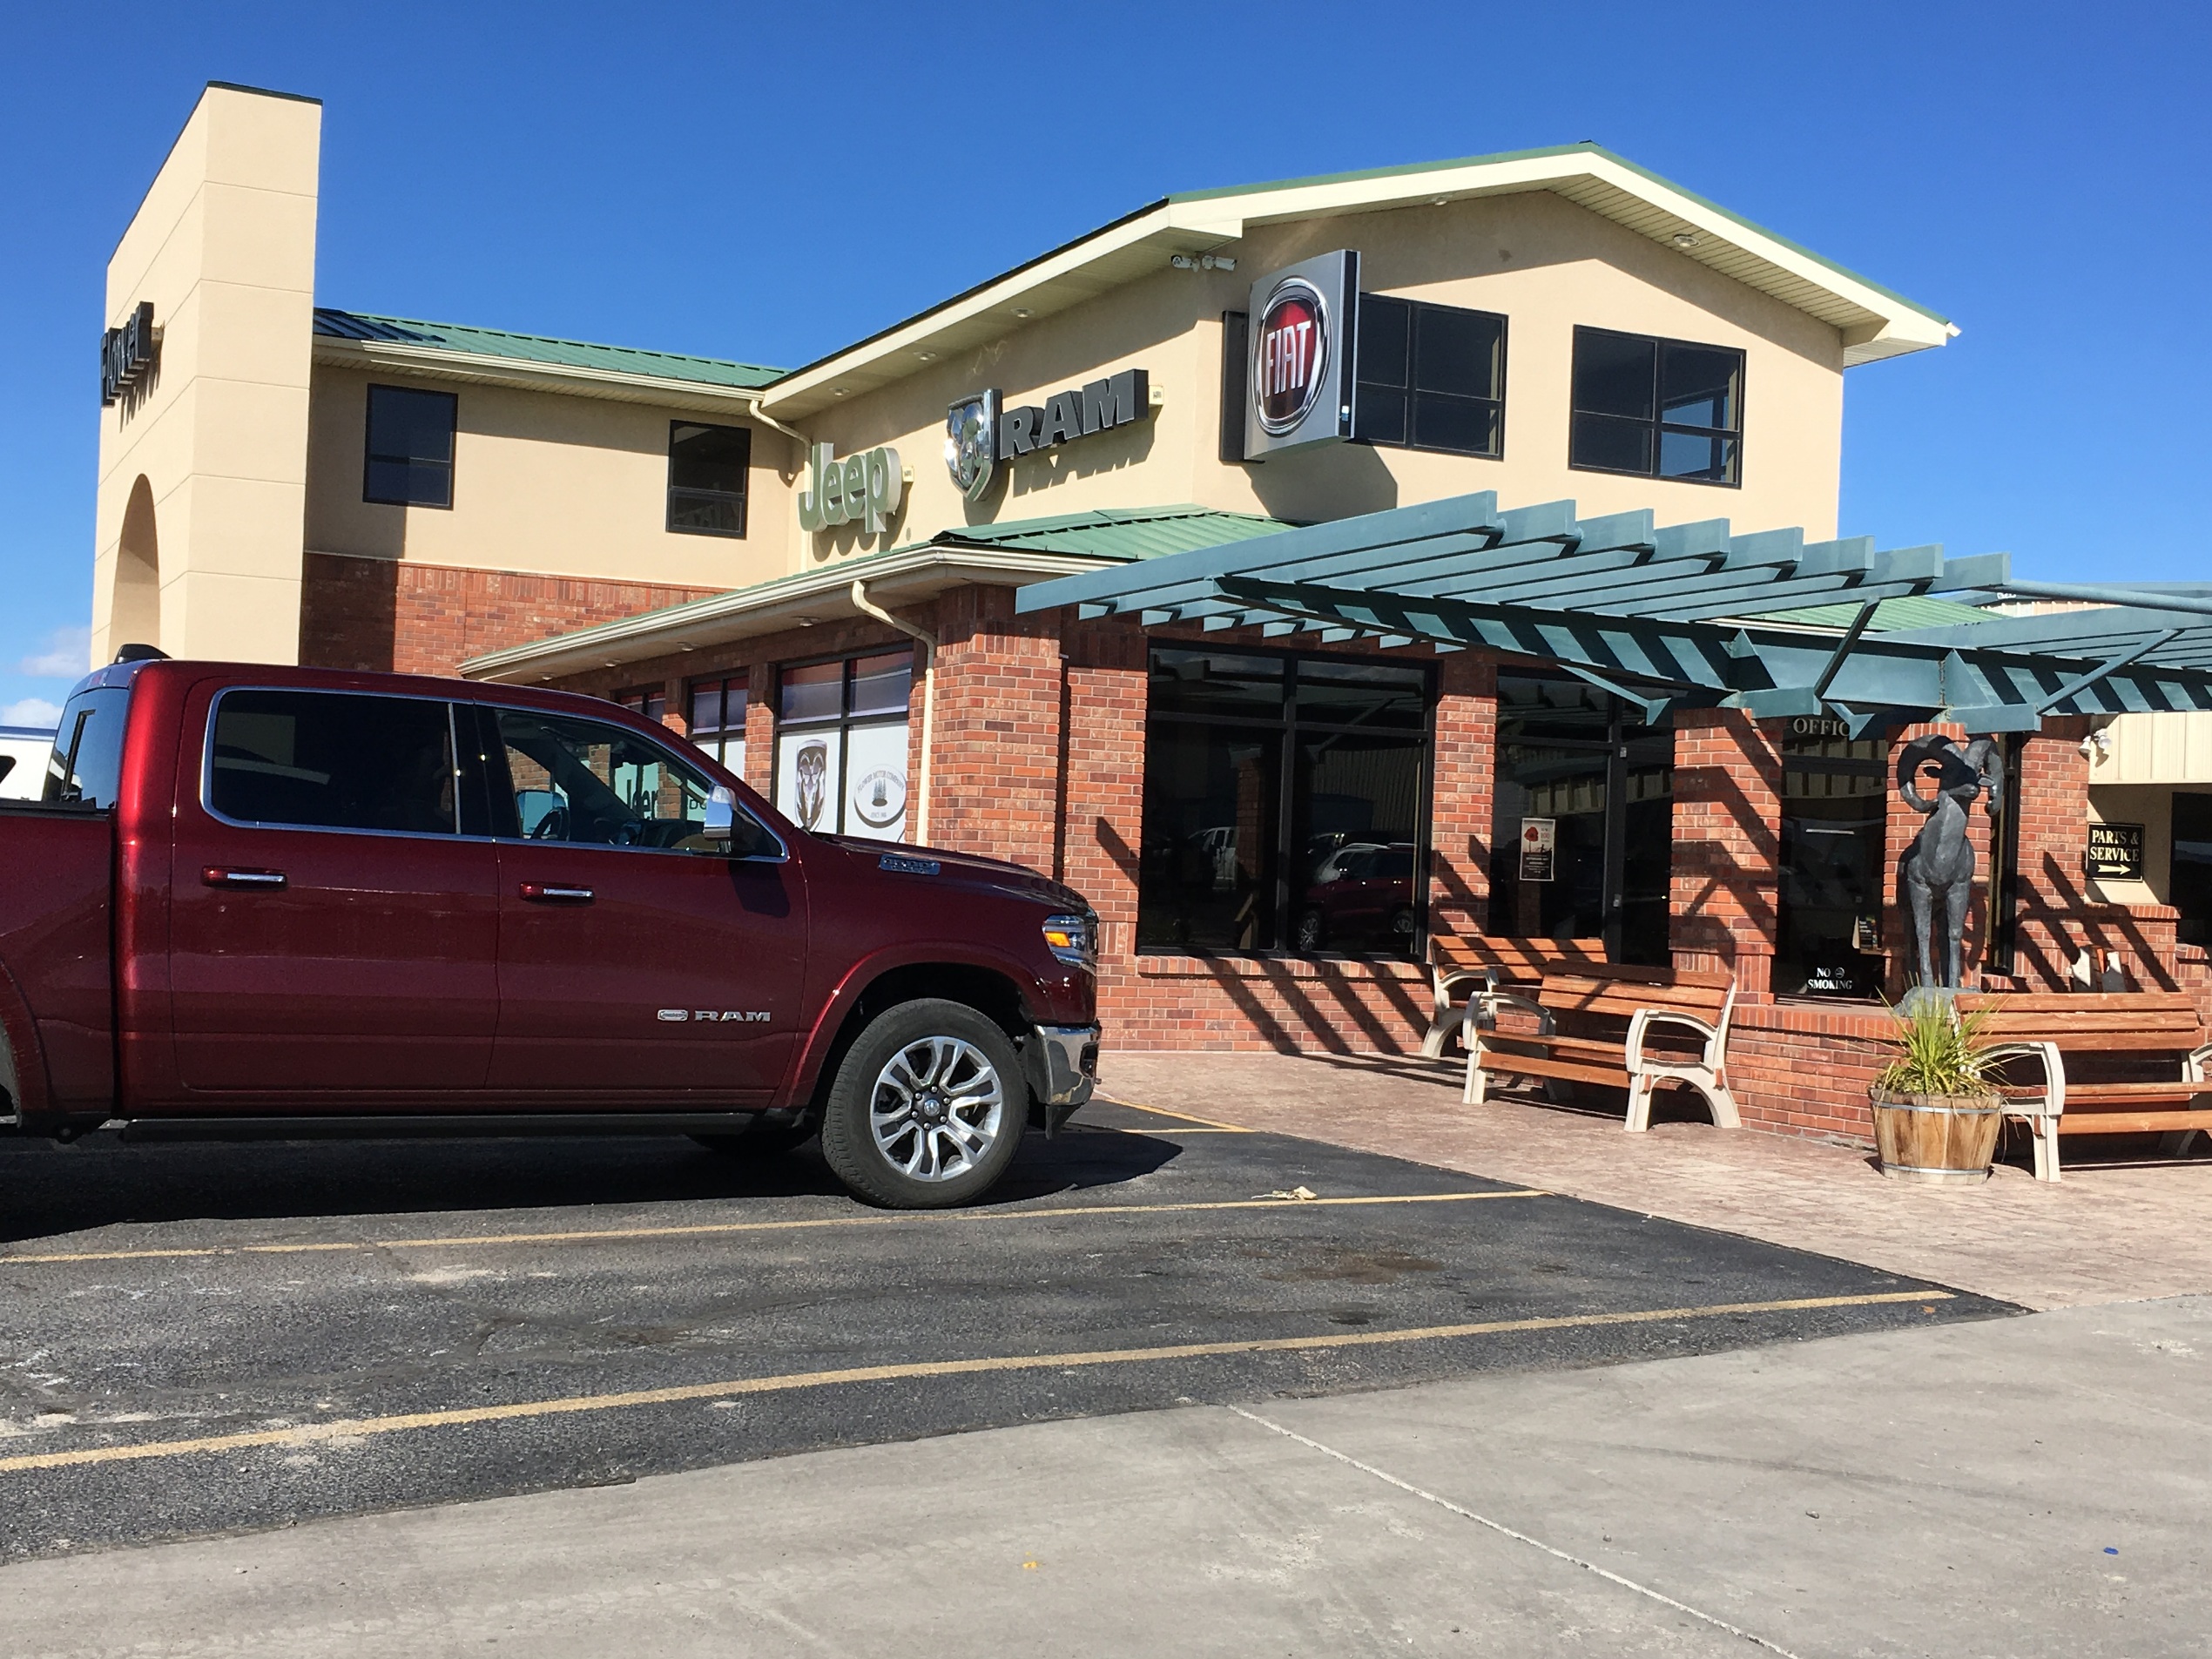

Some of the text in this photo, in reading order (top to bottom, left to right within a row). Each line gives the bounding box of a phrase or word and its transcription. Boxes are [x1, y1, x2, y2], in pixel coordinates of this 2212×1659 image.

[1264, 320, 1312, 398] FIAT
[999, 368, 1149, 460] RAM
[798, 442, 902, 533] Jeep
[1792, 718, 1850, 737] OFFIC
[2092, 829, 2139, 845] PARTS &
[2090, 846, 2140, 862] SERVICE
[1817, 967, 1831, 978] NO
[1807, 978, 1853, 990] SMOKING
[694, 1010, 771, 1022] RAM
